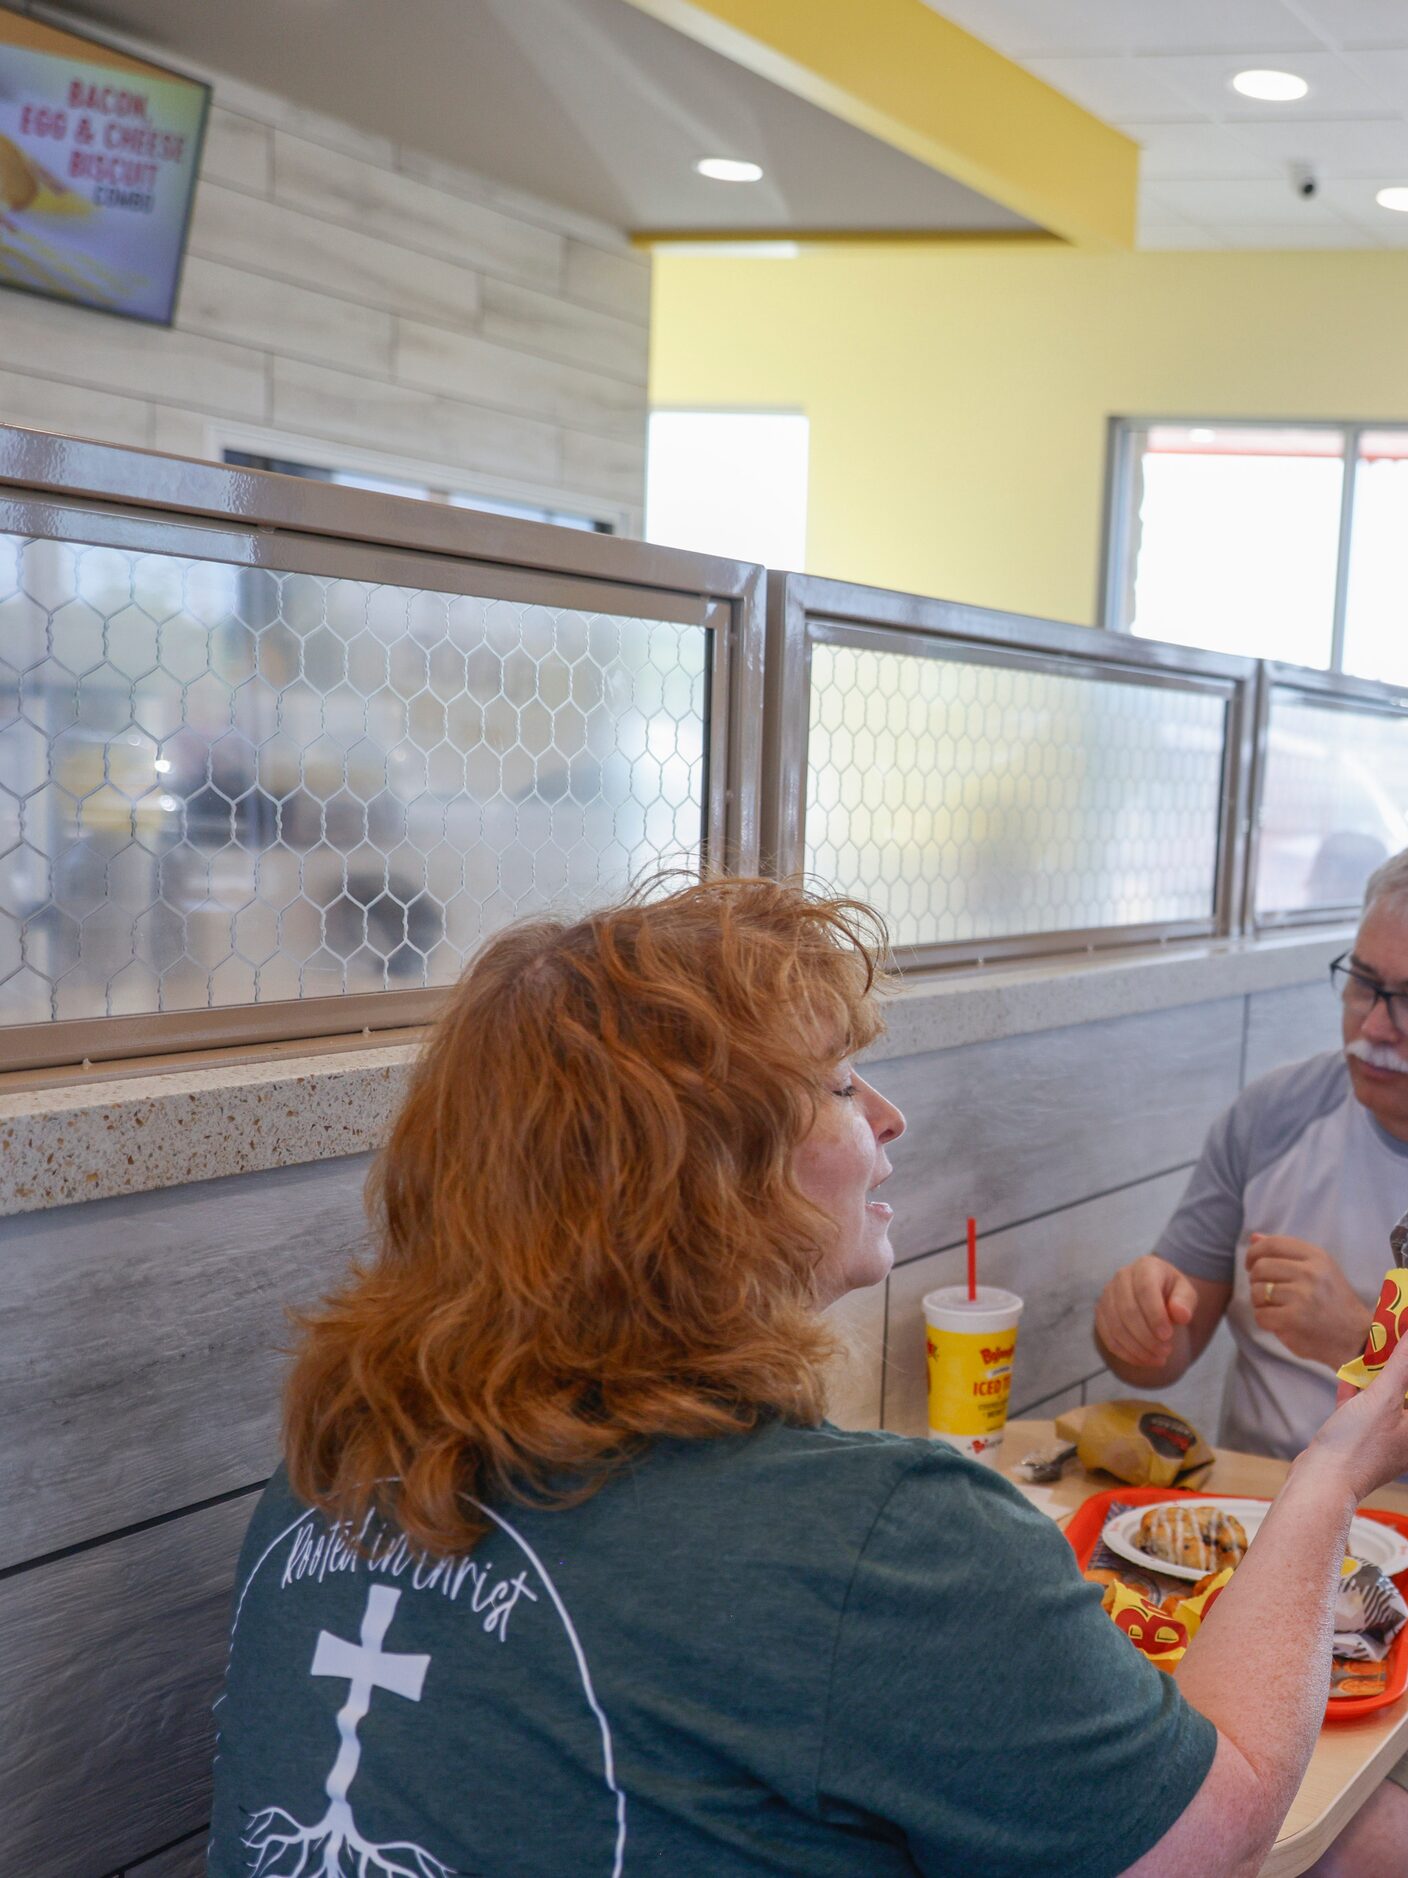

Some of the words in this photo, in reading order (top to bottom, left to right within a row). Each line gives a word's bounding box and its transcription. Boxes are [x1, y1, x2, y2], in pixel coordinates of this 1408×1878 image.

[20, 104, 66, 141] EGG
[75, 117, 95, 145] &
[104, 121, 185, 163] CHEESE
[70, 150, 159, 186] BISCUIT
[973, 1380, 1002, 1397] ICED
[368, 1523, 413, 1577] in
